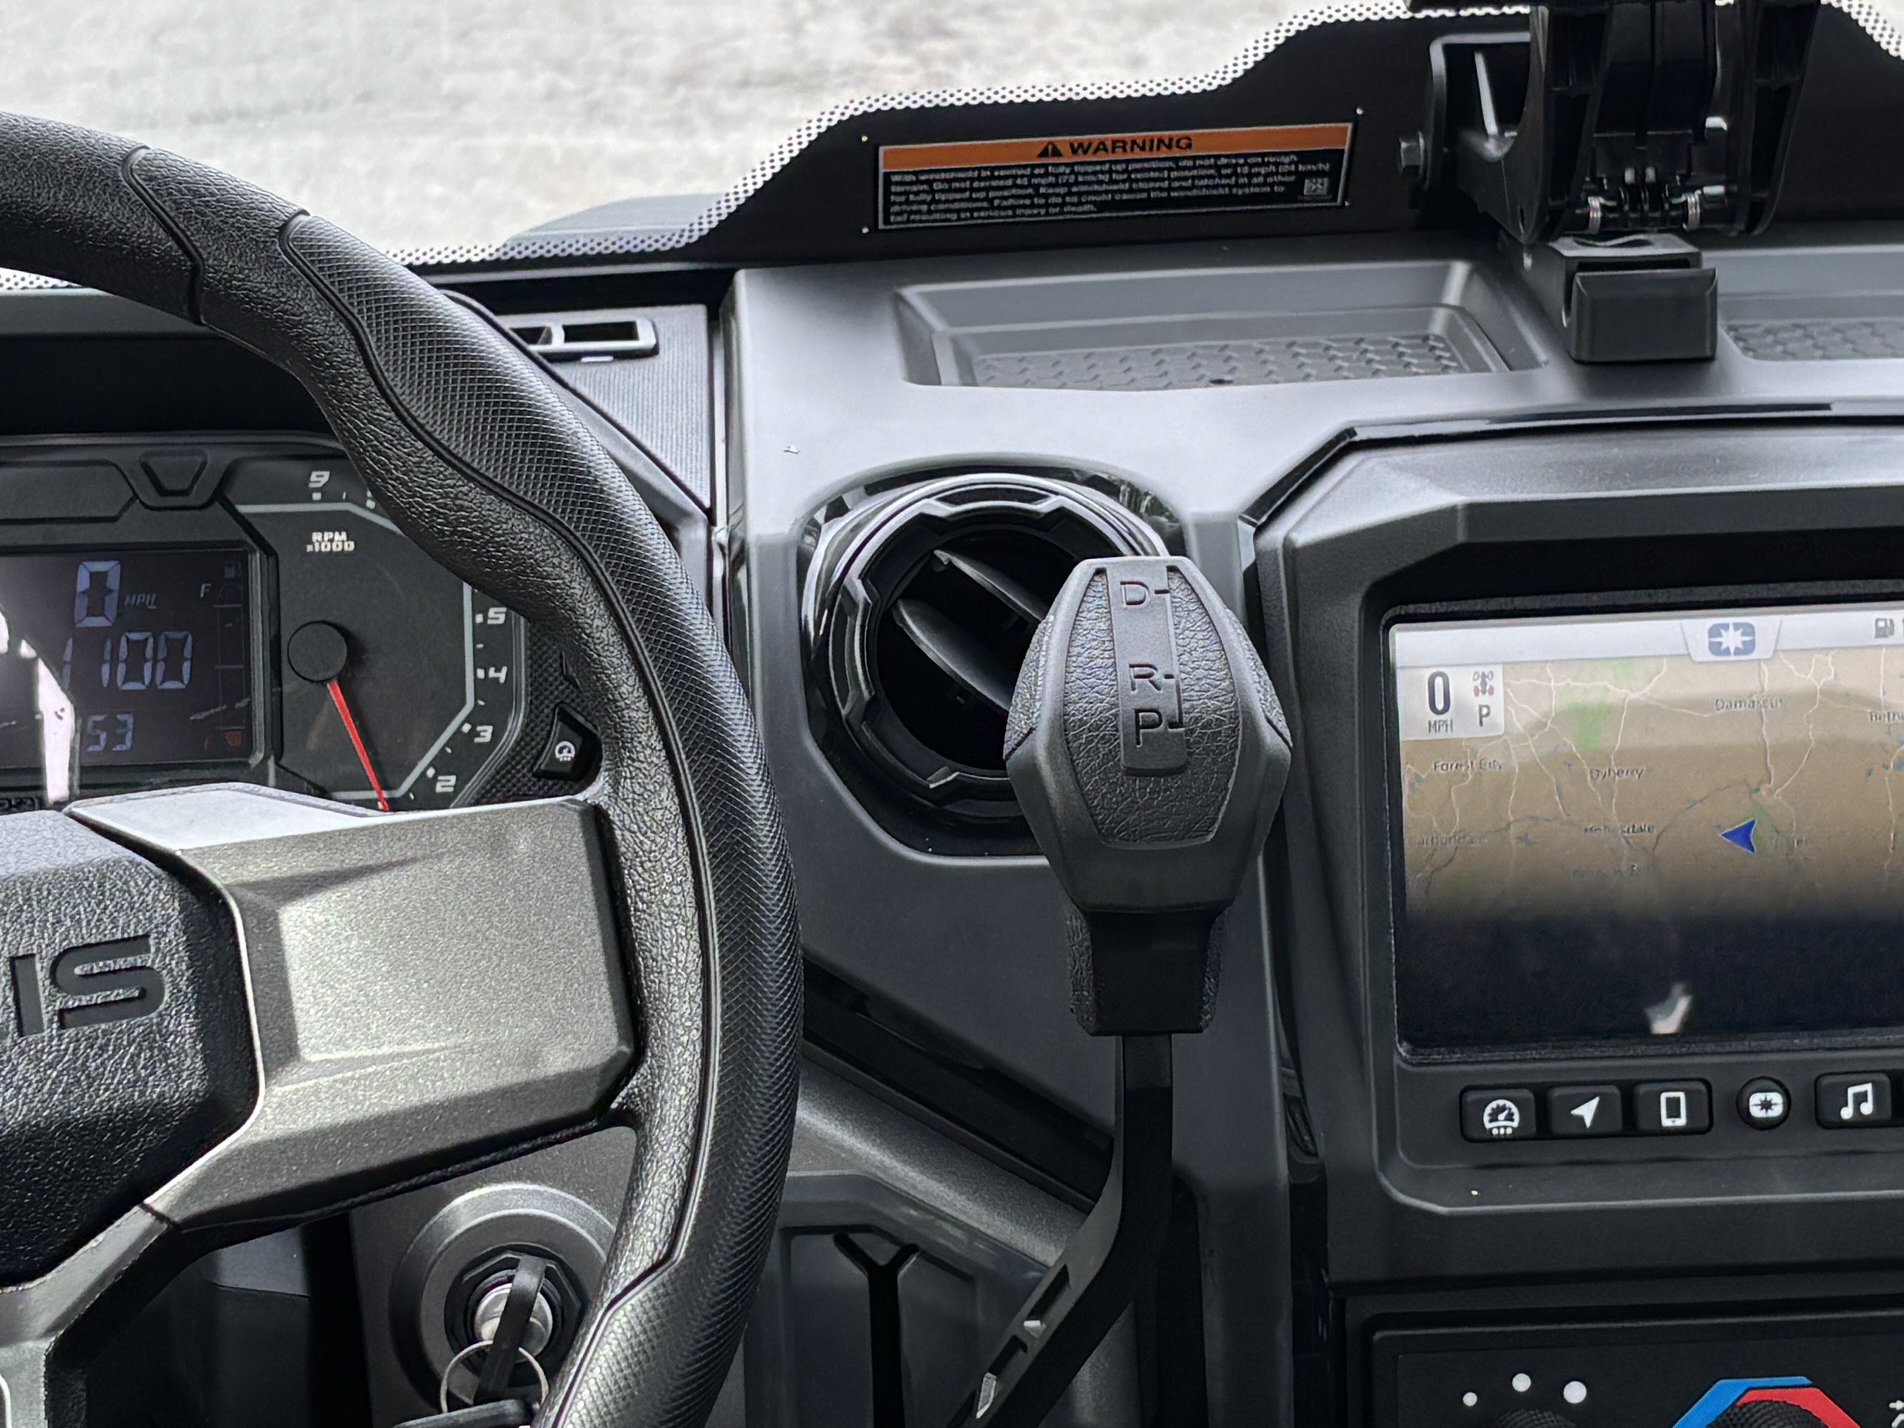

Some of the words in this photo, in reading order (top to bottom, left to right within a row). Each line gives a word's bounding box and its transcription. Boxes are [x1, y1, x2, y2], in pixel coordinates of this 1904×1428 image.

[1069, 136, 1192, 157] WARNING
[308, 470, 330, 488] 9
[312, 531, 347, 542] RPM
[74, 560, 120, 627] 0
[125, 592, 156, 608] MPH
[200, 584, 211, 599] F
[1120, 580, 1146, 607] D
[486, 607, 507, 625] 5
[488, 666, 507, 684] 4
[1129, 662, 1161, 693] R
[1427, 670, 1451, 715] 0
[1478, 704, 1491, 727] P
[474, 725, 493, 743] 3
[1134, 708, 1162, 748] P
[1427, 719, 1454, 734] MPH
[435, 774, 457, 793] 2
